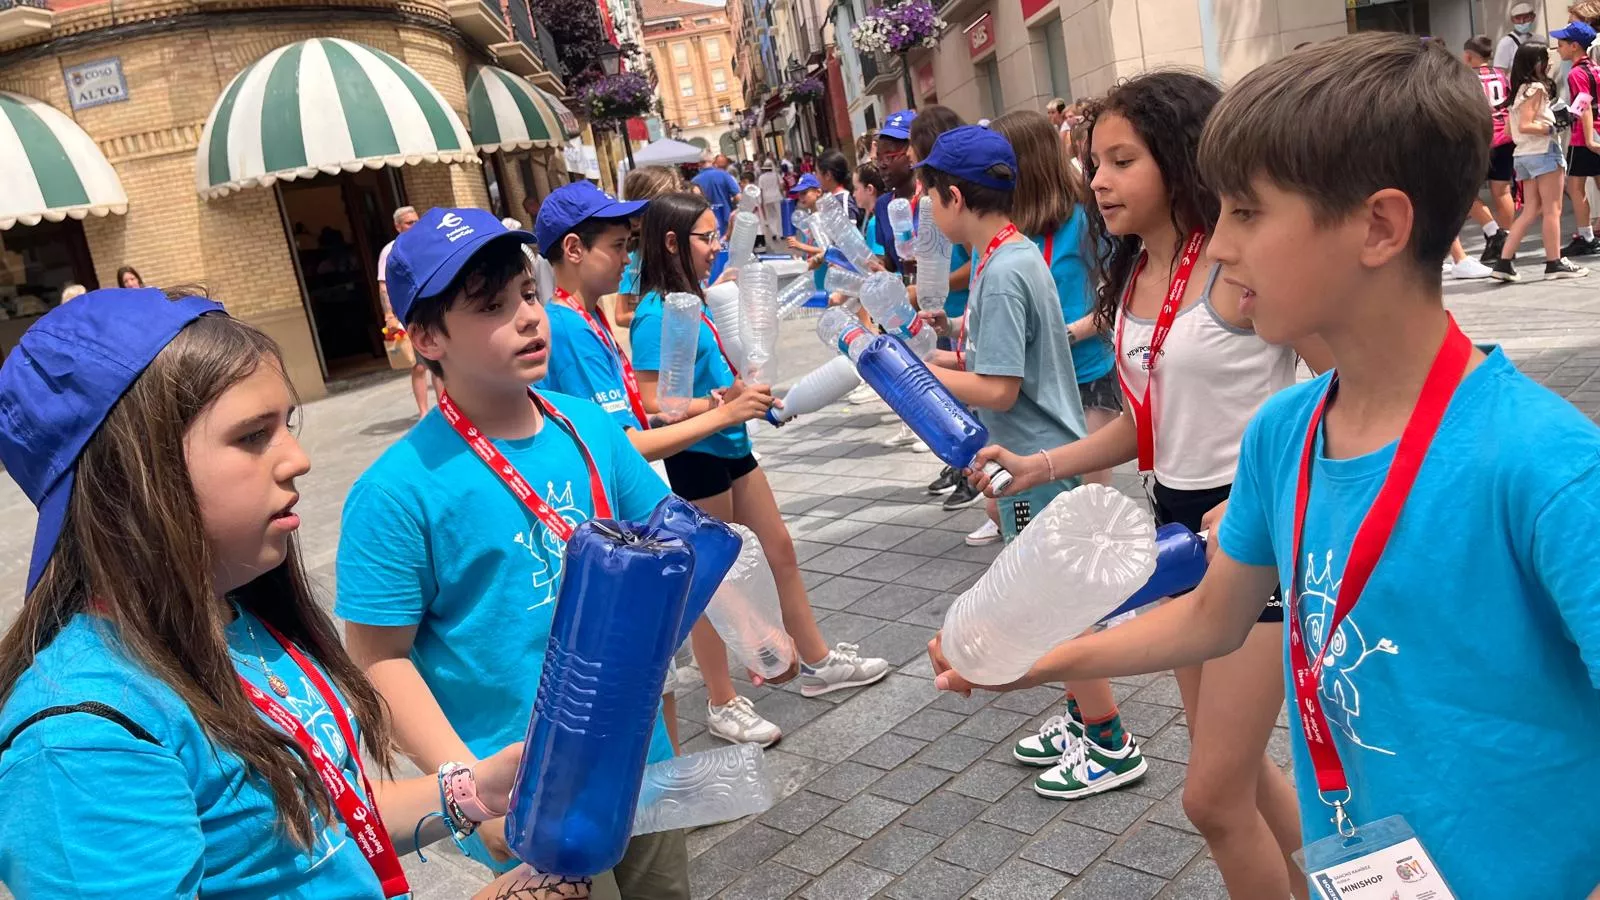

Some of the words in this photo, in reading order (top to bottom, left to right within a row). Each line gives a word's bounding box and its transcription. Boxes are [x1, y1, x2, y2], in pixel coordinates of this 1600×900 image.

[85, 67, 112, 80] COSO
[80, 85, 119, 102] ALTO
[1340, 874, 1383, 894] MINISHOP
